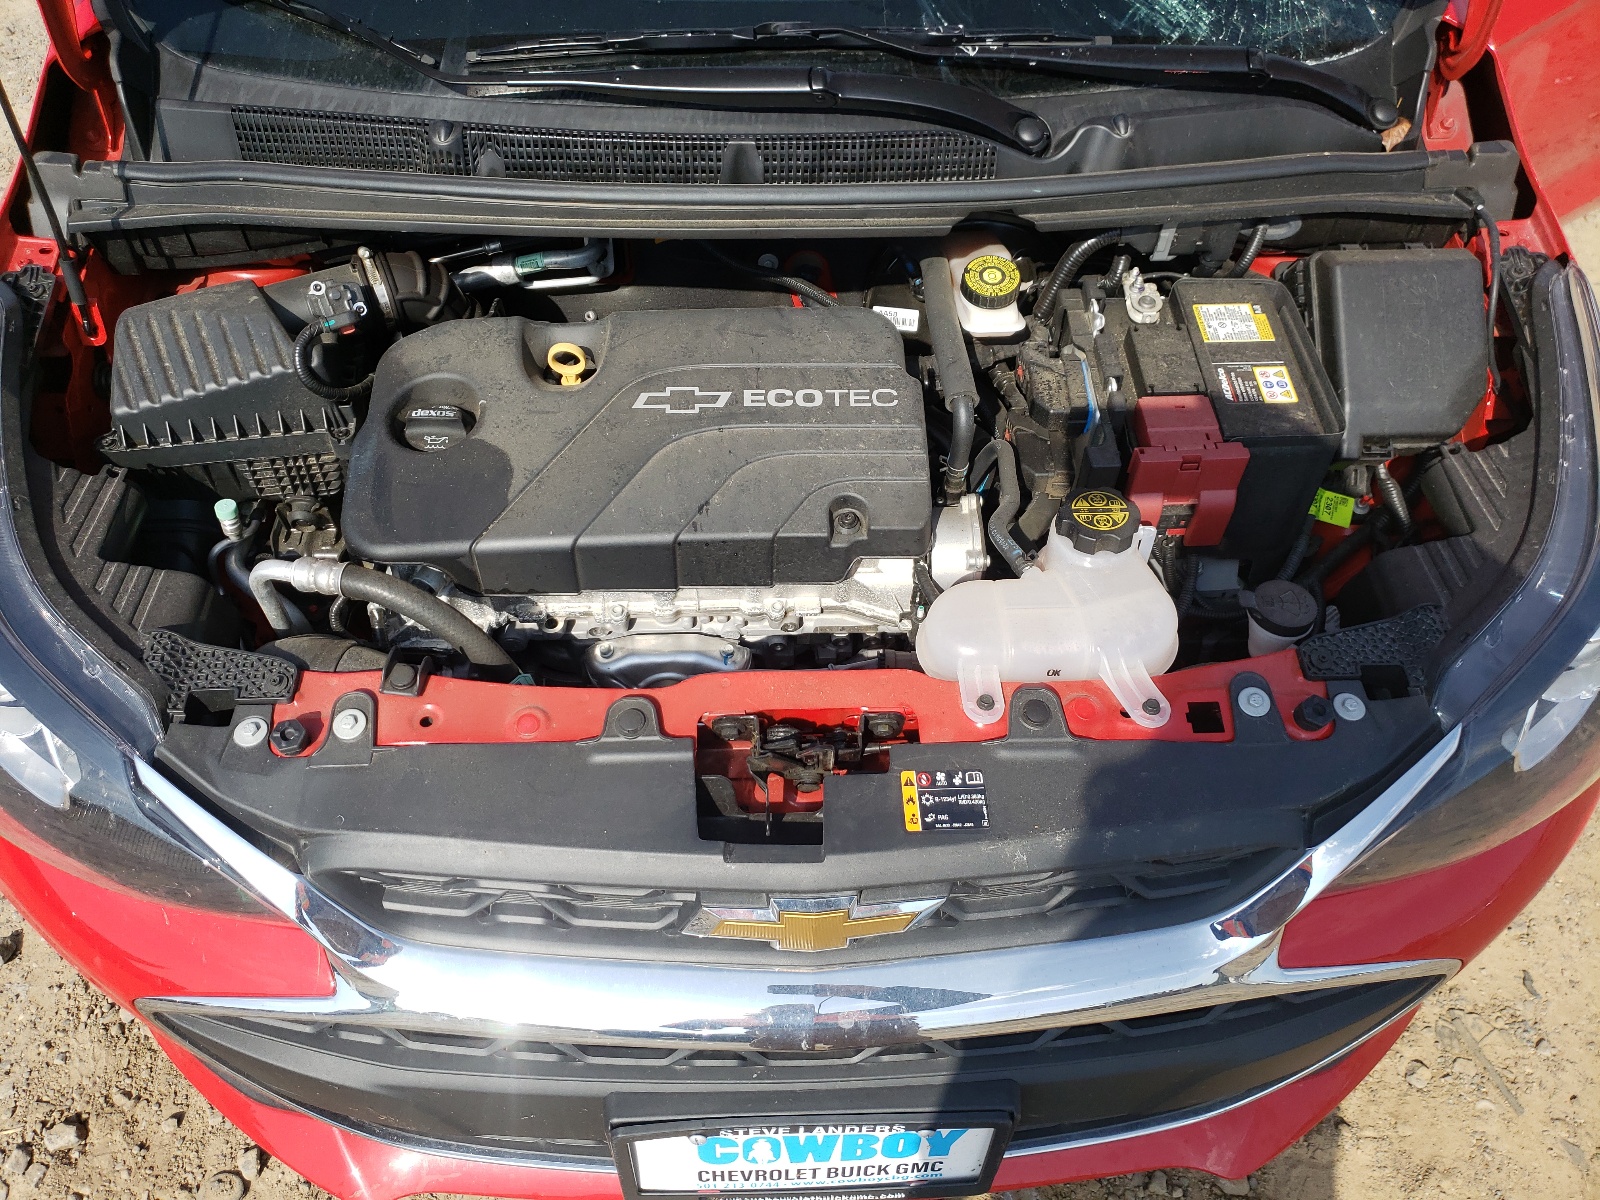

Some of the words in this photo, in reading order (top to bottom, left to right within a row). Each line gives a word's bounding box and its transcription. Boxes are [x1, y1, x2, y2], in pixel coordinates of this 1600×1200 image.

[743, 388, 900, 408] ECOTEC
[411, 408, 457, 417] dexos
[1046, 668, 1062, 677] OK
[719, 1127, 791, 1137] STEVE
[799, 1124, 906, 1135] LANDERS
[697, 1128, 970, 1165] COWBOY
[697, 1167, 822, 1182] CHEVROLET
[826, 1163, 892, 1179] BUICK
[895, 1160, 944, 1175] GMC
